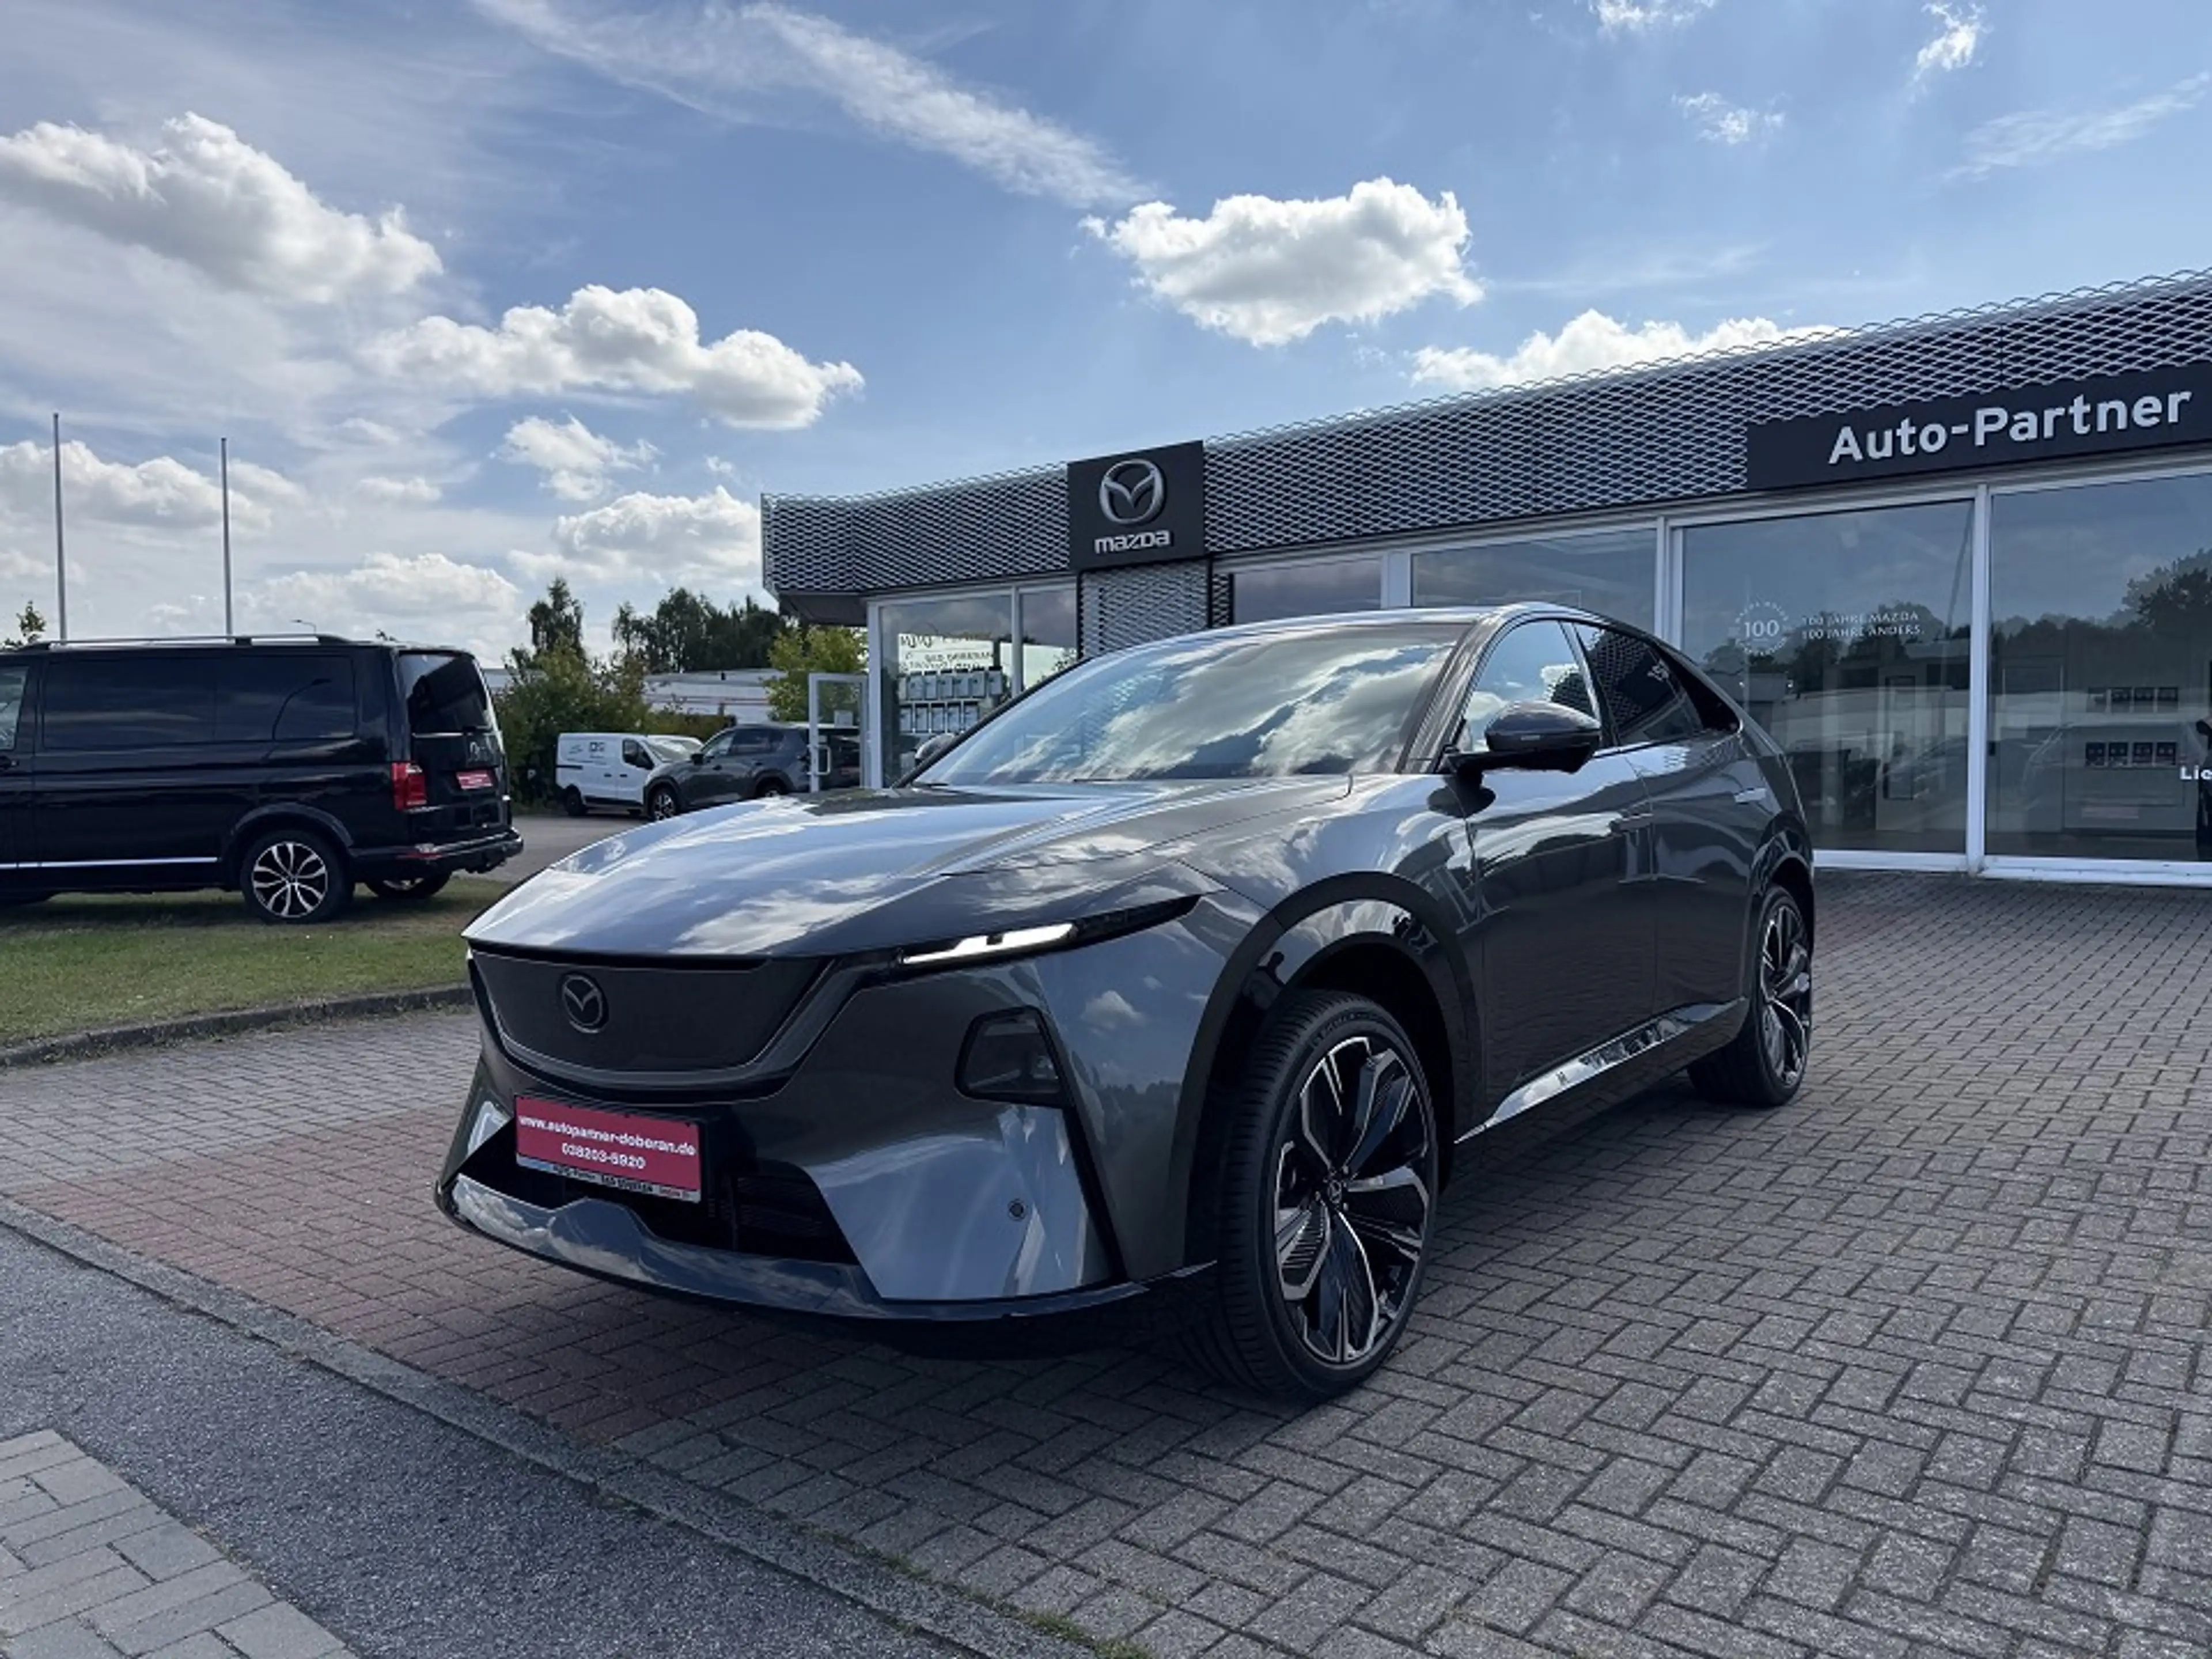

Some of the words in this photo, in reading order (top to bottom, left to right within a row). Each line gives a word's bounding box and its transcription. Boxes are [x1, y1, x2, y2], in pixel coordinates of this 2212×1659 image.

[1828, 390, 2192, 464] Auto-Partner
[1870, 610, 1919, 623] MAZDA
[1744, 620, 1779, 638] 100
[1801, 628, 1823, 639] 100
[1826, 626, 1864, 639] JAHRE
[518, 1115, 696, 1156] www.autopartner-doberan.de
